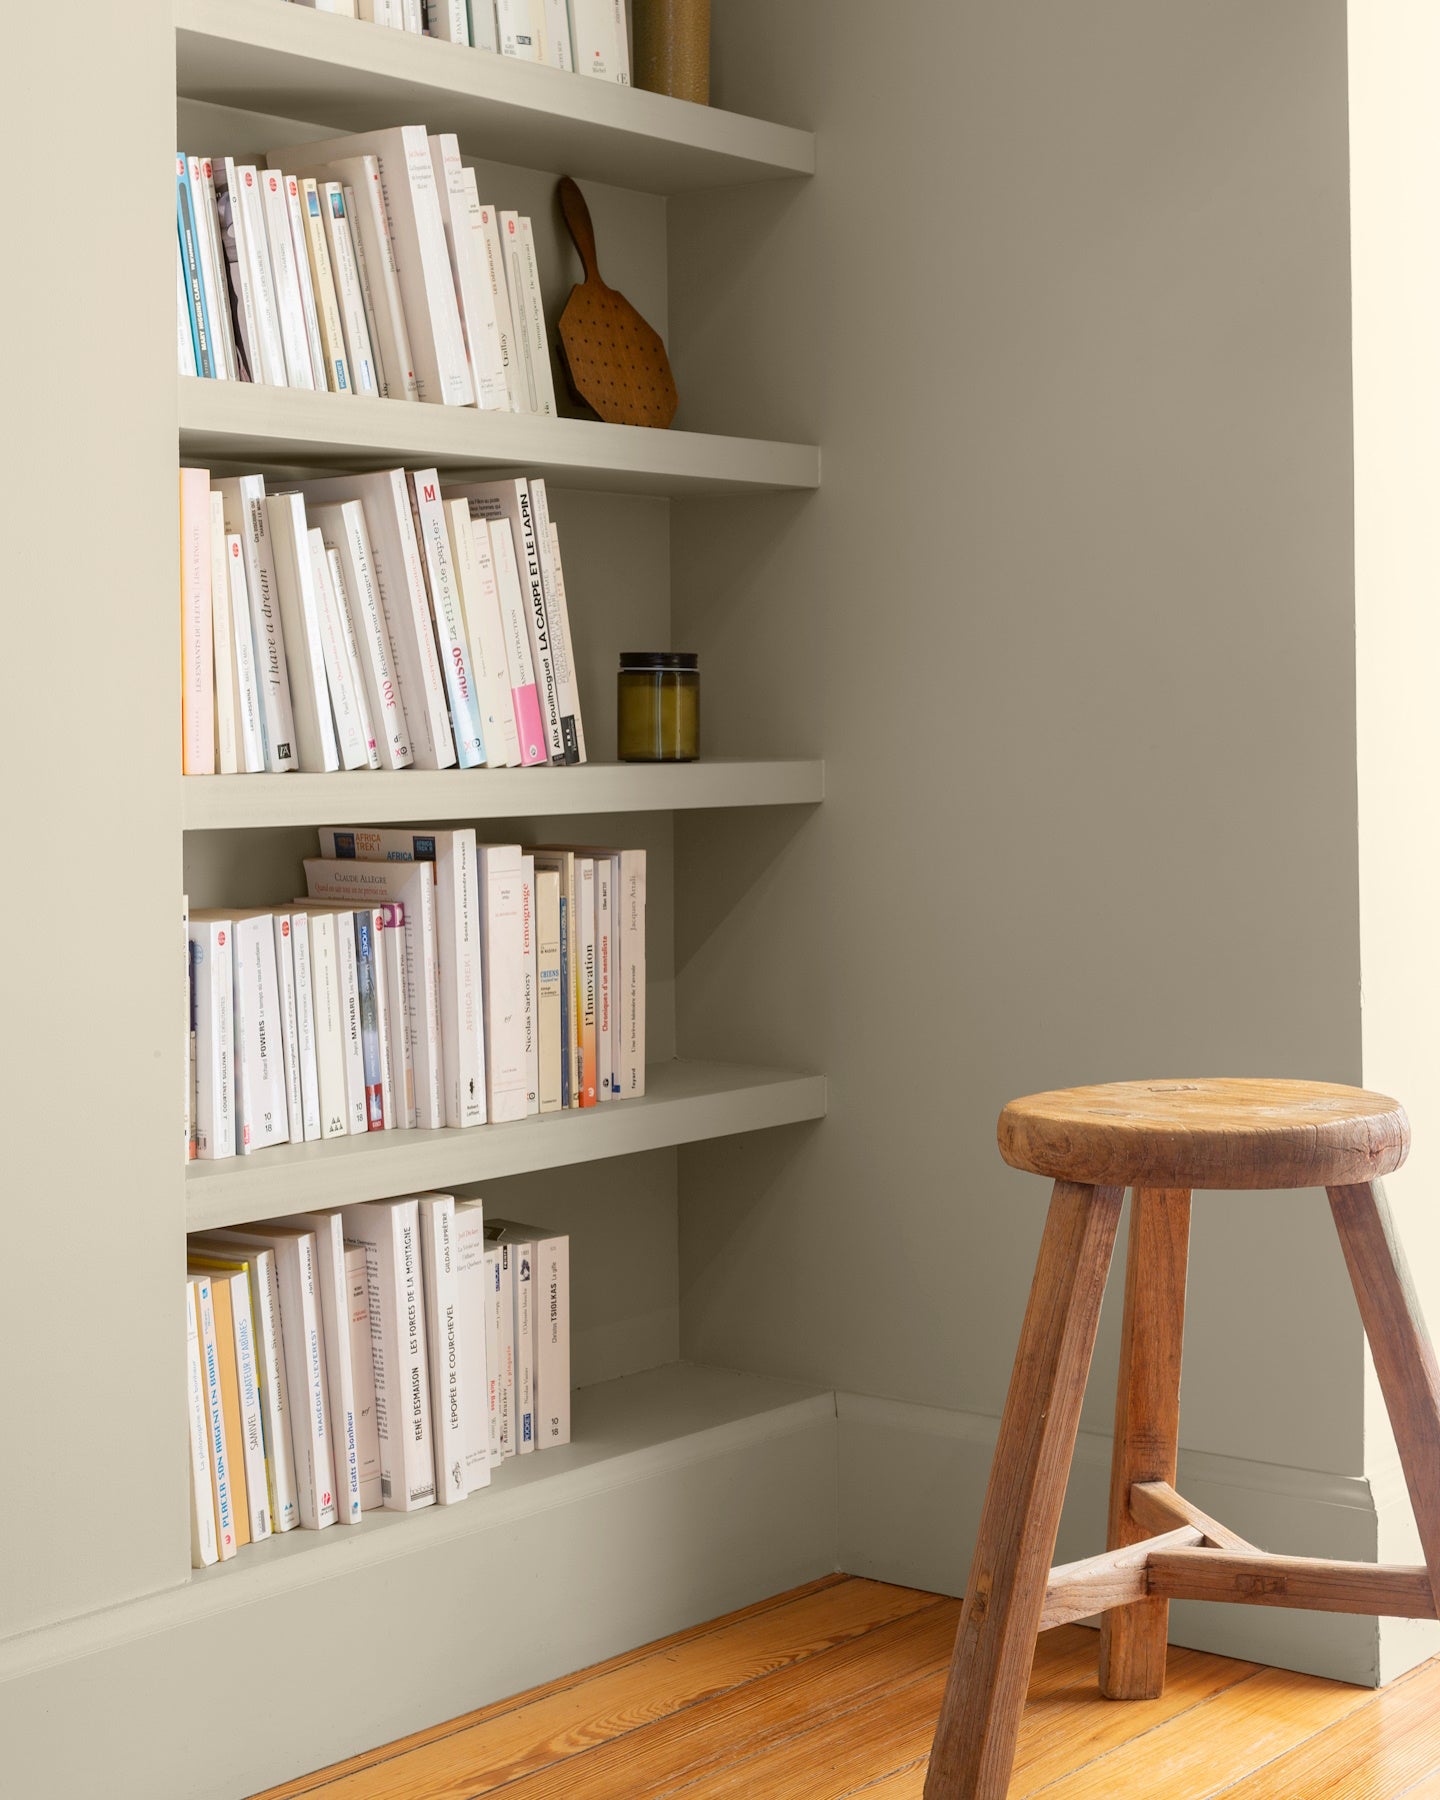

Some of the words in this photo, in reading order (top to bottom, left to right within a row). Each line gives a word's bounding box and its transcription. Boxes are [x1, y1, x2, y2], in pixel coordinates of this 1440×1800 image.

[191, 278, 200, 300] CLARK
[194, 302, 205, 330] HIGGINS
[198, 330, 207, 351] MARY
[498, 332, 510, 367] Gallay
[518, 494, 533, 537] LAPIN
[352, 528, 364, 561] France
[429, 518, 447, 565] papier
[525, 541, 535, 556] LE
[358, 562, 366, 571] la
[438, 567, 448, 584] de
[527, 560, 537, 575] ET
[360, 571, 377, 616] changer
[440, 586, 455, 622] fille
[529, 580, 546, 630] CARPE
[265, 623, 273, 634] a
[371, 617, 381, 634] pour
[448, 629, 458, 641] La
[510, 608, 522, 660] ATTRACTION
[264, 638, 279, 674] have
[373, 635, 389, 677] décisions
[537, 633, 548, 650] LA
[451, 646, 470, 698] MUSSO
[382, 679, 397, 710] 300
[539, 657, 560, 725] Bouilhaguet
[551, 726, 561, 749] Alix
[356, 833, 381, 842] AFRICA
[357, 842, 374, 851] TREK
[387, 852, 412, 860] AFRICA
[629, 900, 637, 930] Jacques
[463, 960, 471, 987] TREK
[584, 944, 594, 1025] l'Innovation
[523, 972, 532, 1012] Sarkozy
[464, 990, 473, 1031] AFRICA
[601, 992, 610, 1031] Chroniques
[258, 1020, 266, 1057] POWERS
[524, 1016, 532, 1052] Nicolas
[264, 1112, 272, 1120] 10
[356, 1102, 362, 1110] 10
[356, 1114, 364, 1122] 18
[265, 1124, 273, 1132] 18
[304, 1246, 312, 1280] Krakauer
[403, 1226, 413, 1273] MONTAGNE
[443, 1246, 451, 1273] GILDAS
[263, 1262, 272, 1296] homme
[406, 1276, 414, 1288] LA
[551, 1272, 556, 1280] La
[267, 1300, 273, 1312] un
[406, 1291, 414, 1301] DE
[407, 1304, 416, 1336] FORCES
[236, 1318, 250, 1360] D'ABÎMES
[270, 1340, 277, 1349] Si
[409, 1339, 417, 1354] LES
[445, 1304, 456, 1368] COURCHEVEL
[206, 1343, 216, 1385] BOURSE
[309, 1329, 319, 1379] L'EVEREST
[190, 1359, 198, 1392] bonheur
[241, 1361, 255, 1407] L'AMATEUR
[411, 1366, 421, 1415] DESMAISON
[448, 1371, 456, 1383] DE
[506, 1378, 512, 1386] Le
[210, 1389, 218, 1405] EN
[274, 1382, 283, 1411] Primo
[448, 1386, 459, 1429] L'ÉPOPÉE
[314, 1390, 324, 1437] TRAGÉDIE
[195, 1415, 205, 1458] philosophie
[212, 1409, 222, 1453] ARGENT
[246, 1413, 259, 1450] SAMIVEL
[345, 1411, 354, 1449] bonheur
[412, 1418, 423, 1440] RENÉ
[552, 1428, 559, 1436] 18
[199, 1461, 204, 1470] La
[216, 1456, 225, 1480] SON
[348, 1452, 355, 1463] du
[349, 1466, 358, 1492] éclats
[219, 1483, 229, 1527] PLACER
